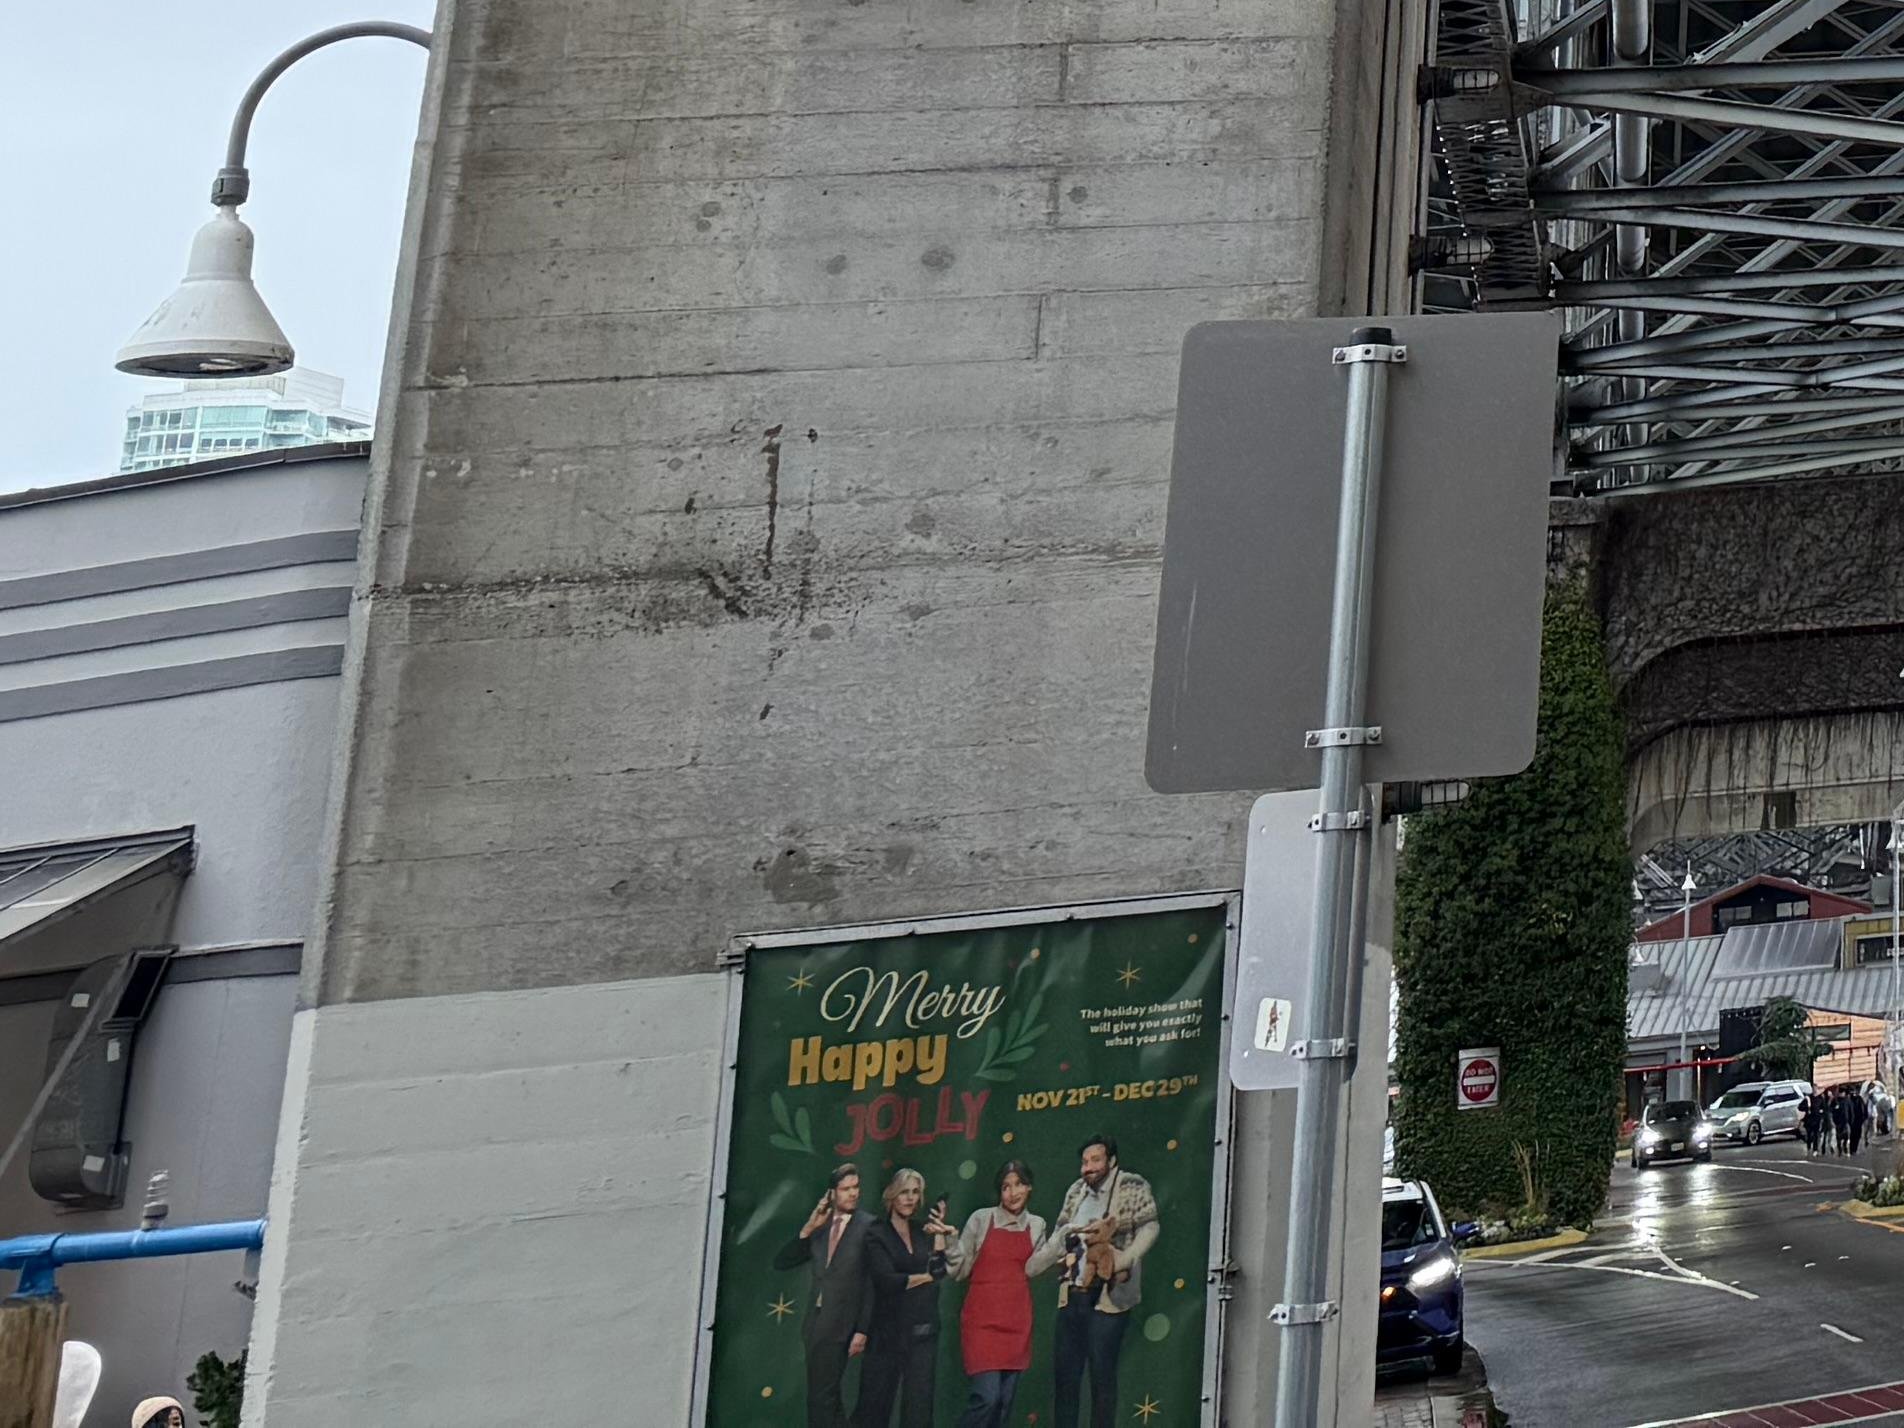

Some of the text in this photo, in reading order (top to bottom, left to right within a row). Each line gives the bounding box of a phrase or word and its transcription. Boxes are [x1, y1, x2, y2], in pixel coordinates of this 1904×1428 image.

[820, 966, 1006, 1039] Merry
[1080, 998, 1202, 1019] The holiday show that
[1090, 1014, 1202, 1033] will give you exactly
[1105, 1036, 1133, 1047] what
[1136, 1035, 1157, 1046] you
[1159, 1031, 1178, 1041] ask
[788, 1034, 948, 1091] Happy
[1017, 1090, 1064, 1111] NOV
[1113, 1080, 1155, 1101] DEC
[834, 1085, 992, 1156] JOLLY
